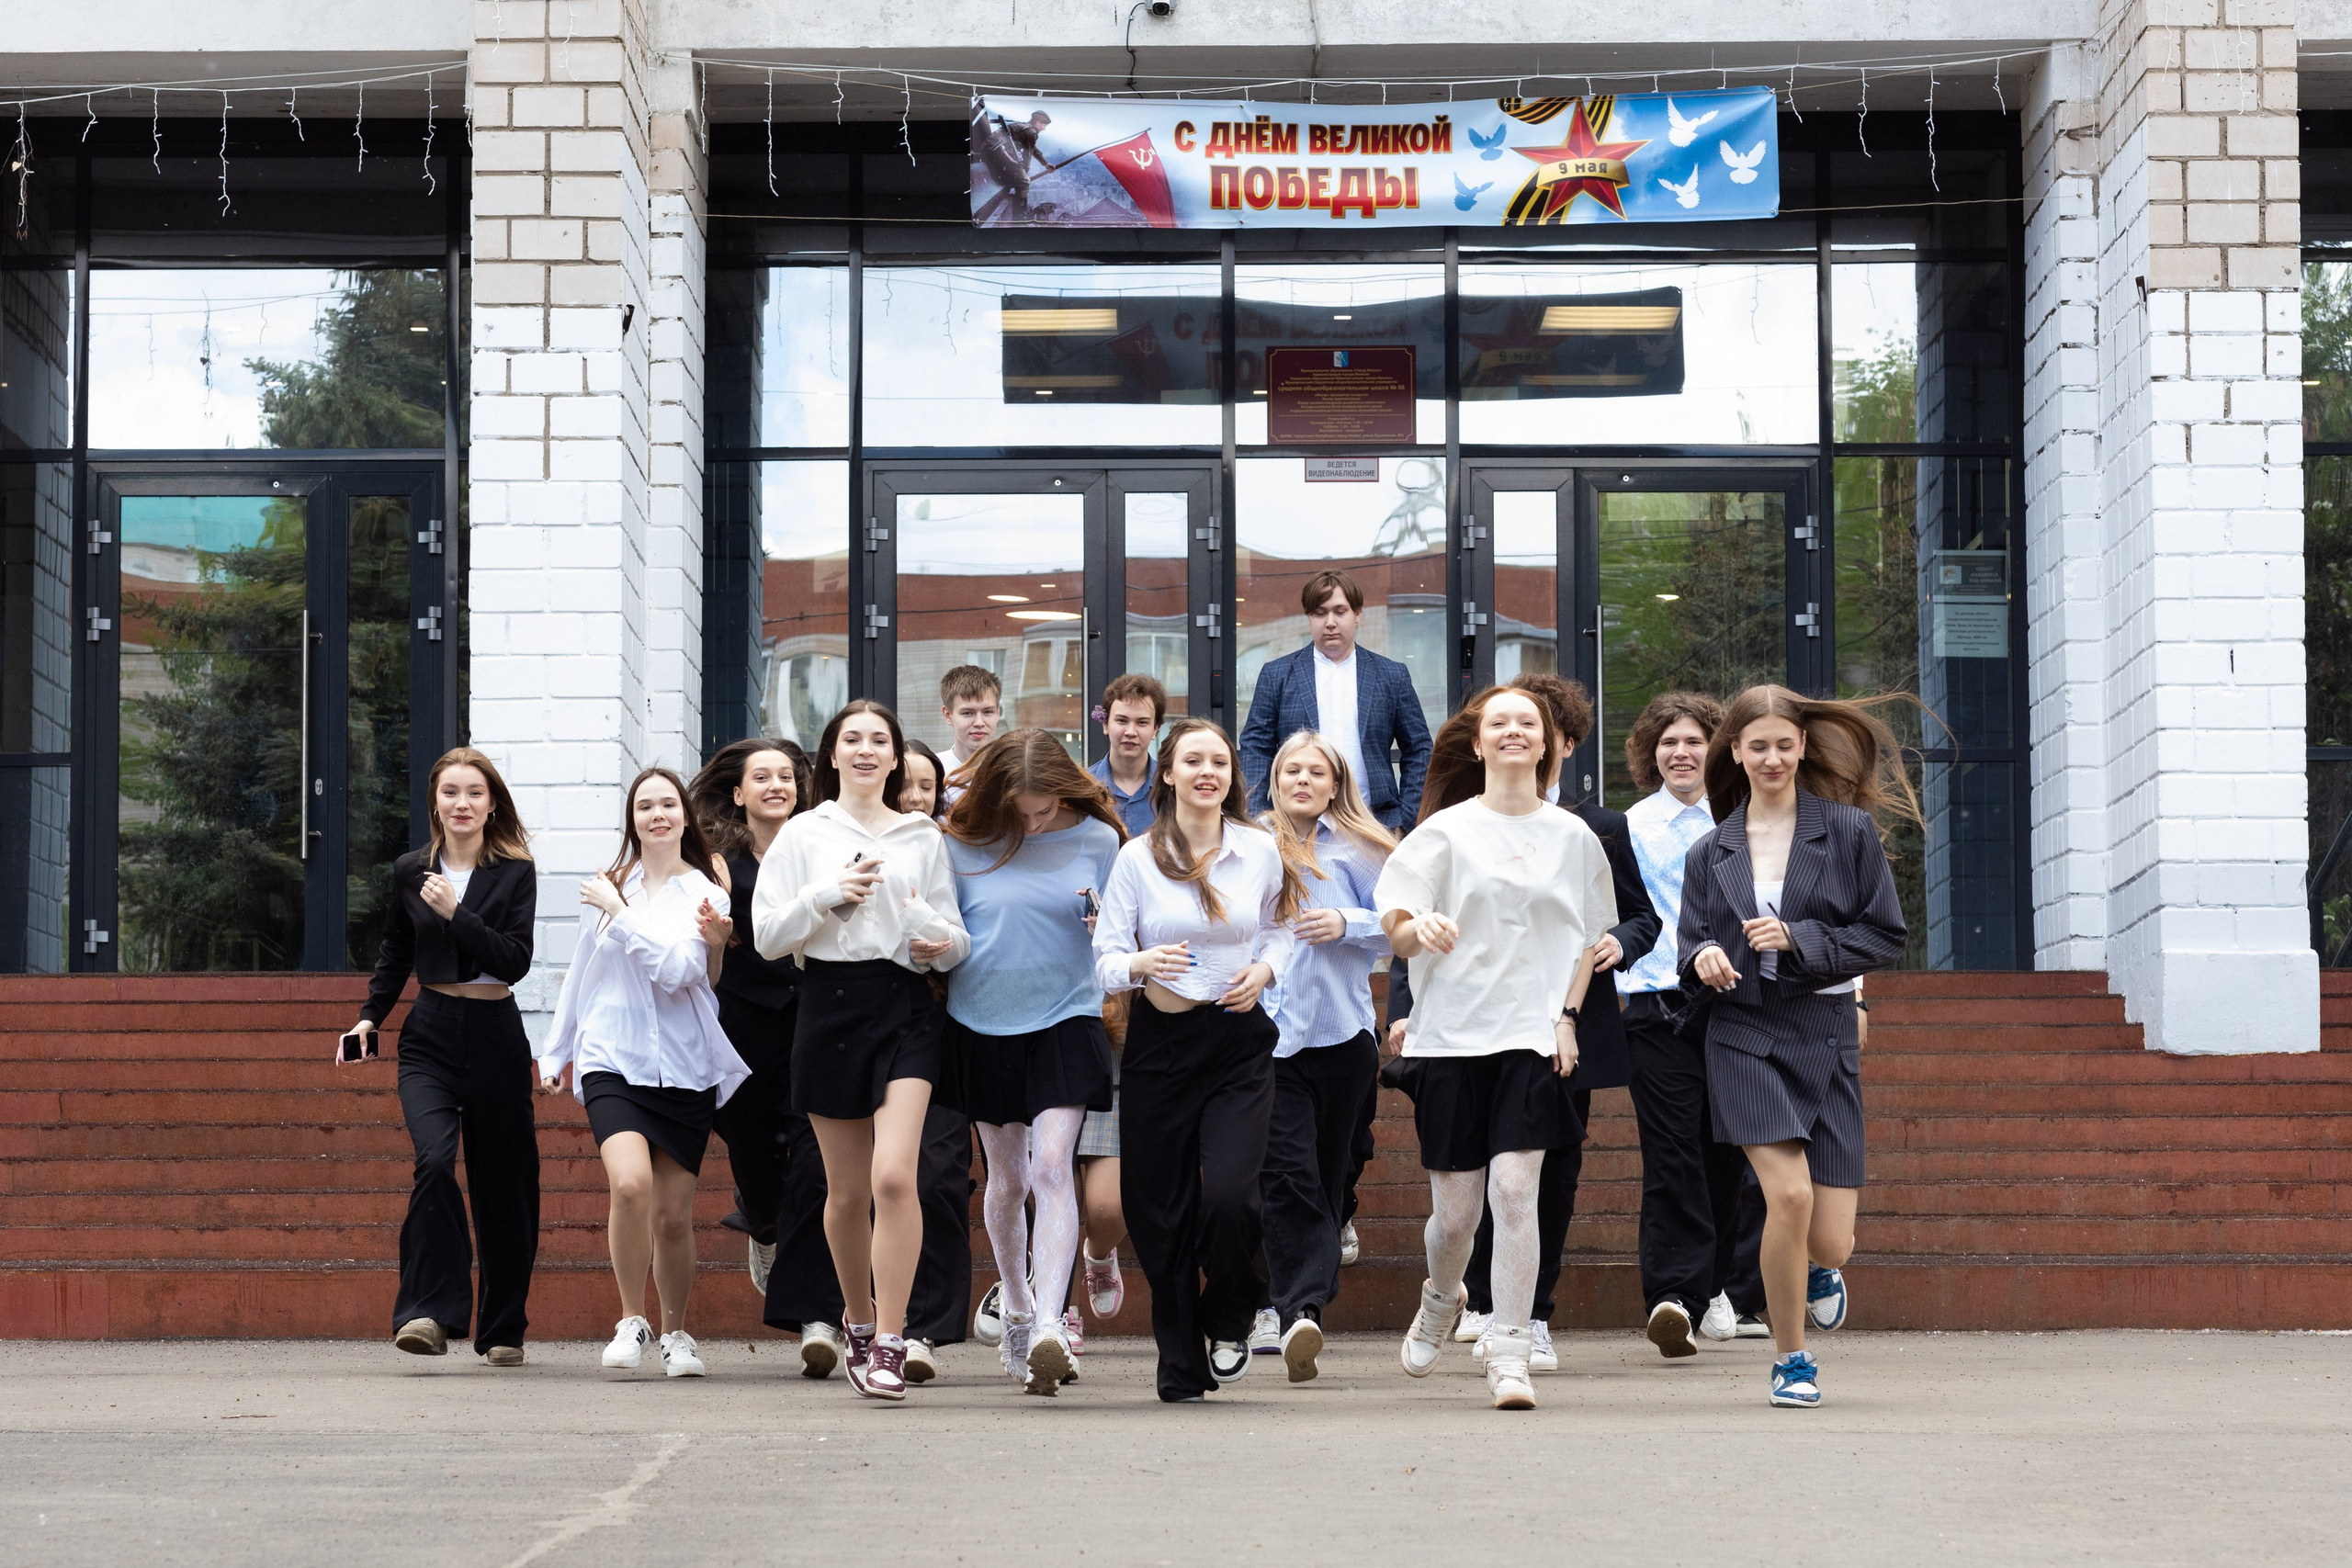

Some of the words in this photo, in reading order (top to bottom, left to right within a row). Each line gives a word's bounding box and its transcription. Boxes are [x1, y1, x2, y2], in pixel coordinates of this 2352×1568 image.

[1174, 120, 1197, 153] С
[1204, 115, 1299, 159] ДНЁМ
[1308, 114, 1453, 156] ВЕЛИКОЙ
[1558, 162, 1568, 175] 9
[1575, 162, 1608, 174] мая
[1209, 164, 1419, 219] ПОБЕДЫ
[1328, 460, 1357, 468] ВЕДЕТСЯ
[1308, 469, 1375, 478] ВИДЕОНАБЛЮДЕНИЕ
